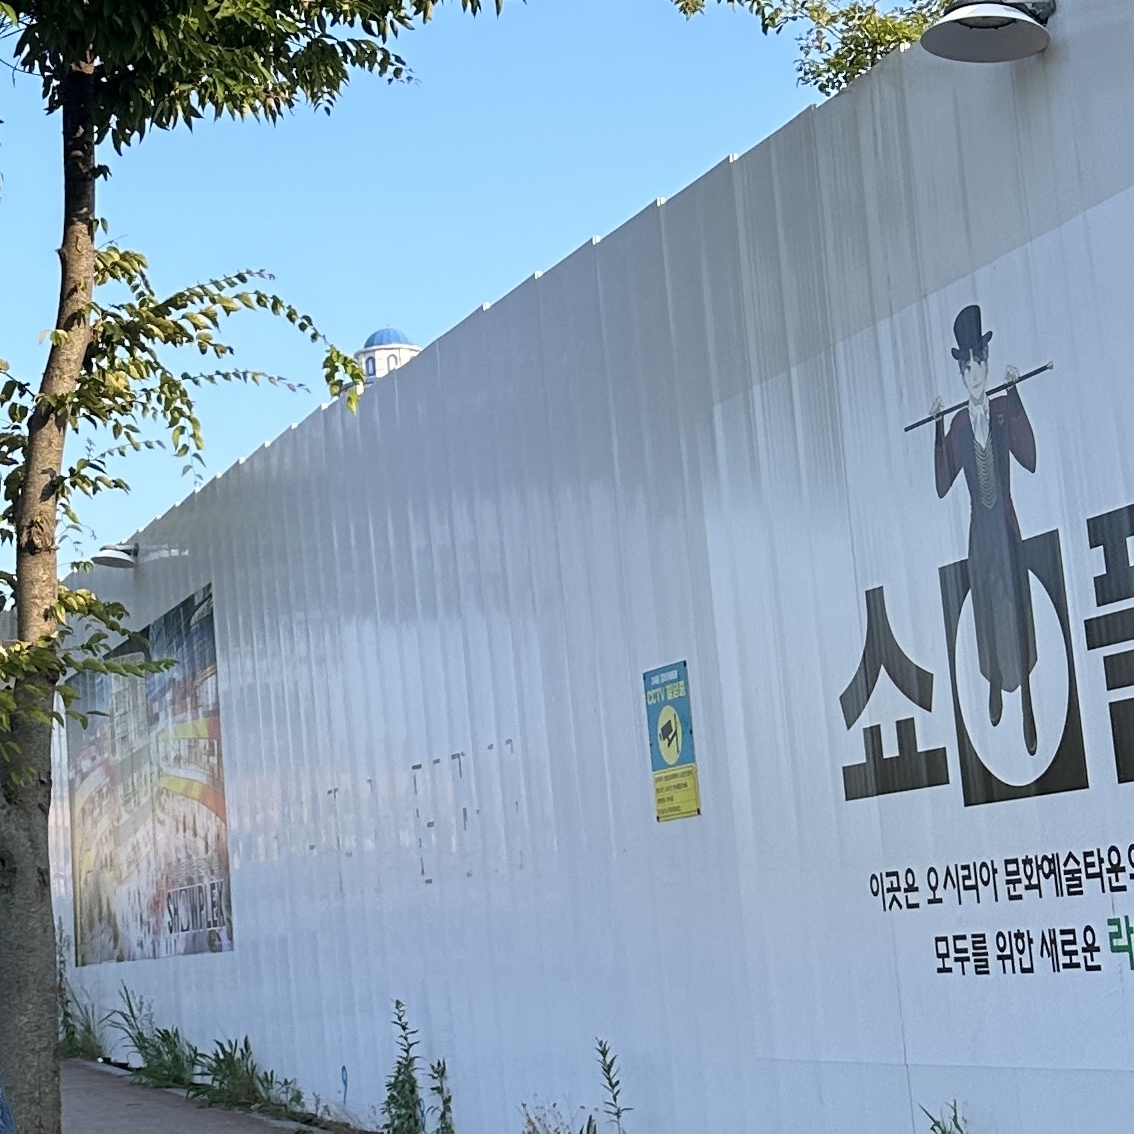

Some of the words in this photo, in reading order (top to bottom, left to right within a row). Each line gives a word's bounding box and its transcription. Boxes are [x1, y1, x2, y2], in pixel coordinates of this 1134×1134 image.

[647, 687, 665, 705] CCTV
[167, 882, 226, 935] SHOWPLEX
[869, 867, 920, 911] 이곳은
[927, 860, 998, 905] 오시리아
[934, 933, 990, 975] 모두를
[995, 929, 1034, 974] 위한
[1040, 925, 1102, 972] 새로운
